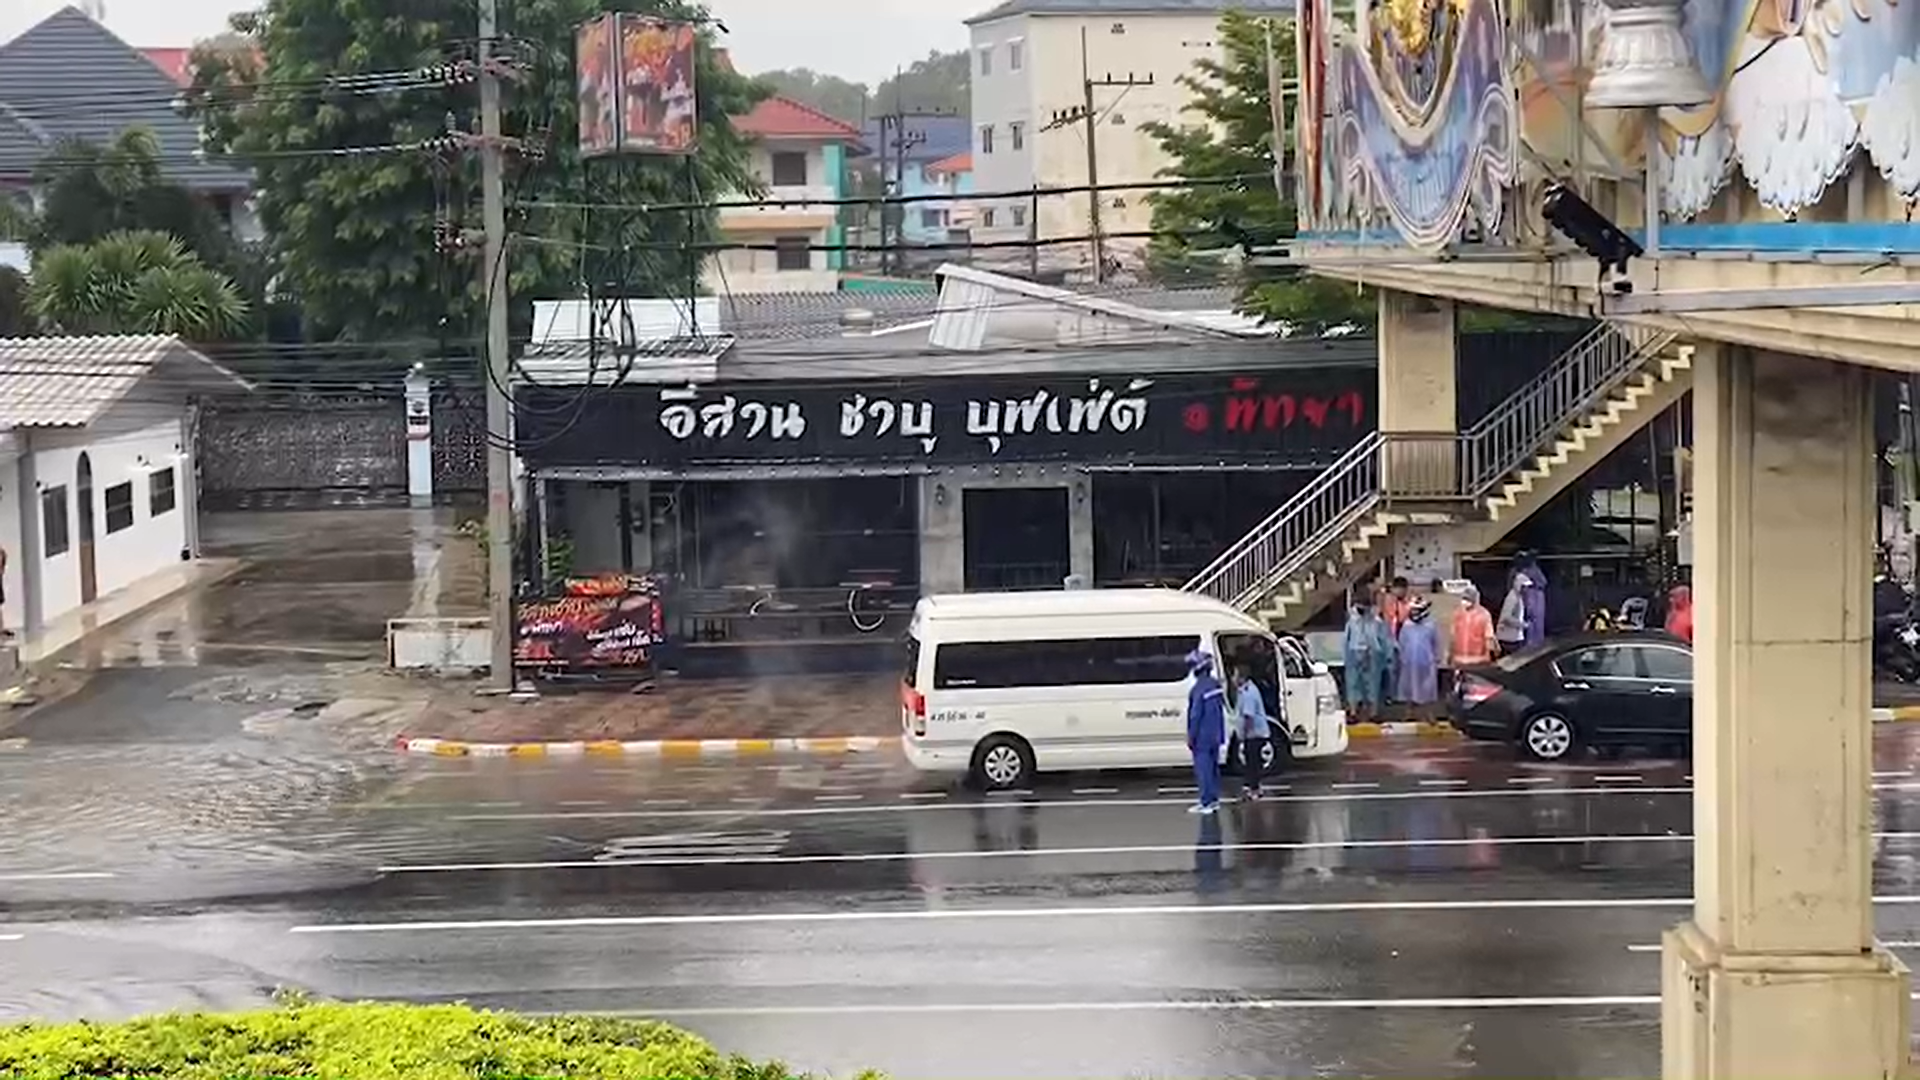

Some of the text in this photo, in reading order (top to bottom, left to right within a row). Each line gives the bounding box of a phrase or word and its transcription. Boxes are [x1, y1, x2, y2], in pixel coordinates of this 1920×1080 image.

[660, 384, 806, 438] อีสาน
[840, 393, 937, 454] ชาบู
[967, 378, 1155, 454] บุฟเฟ่ต์
